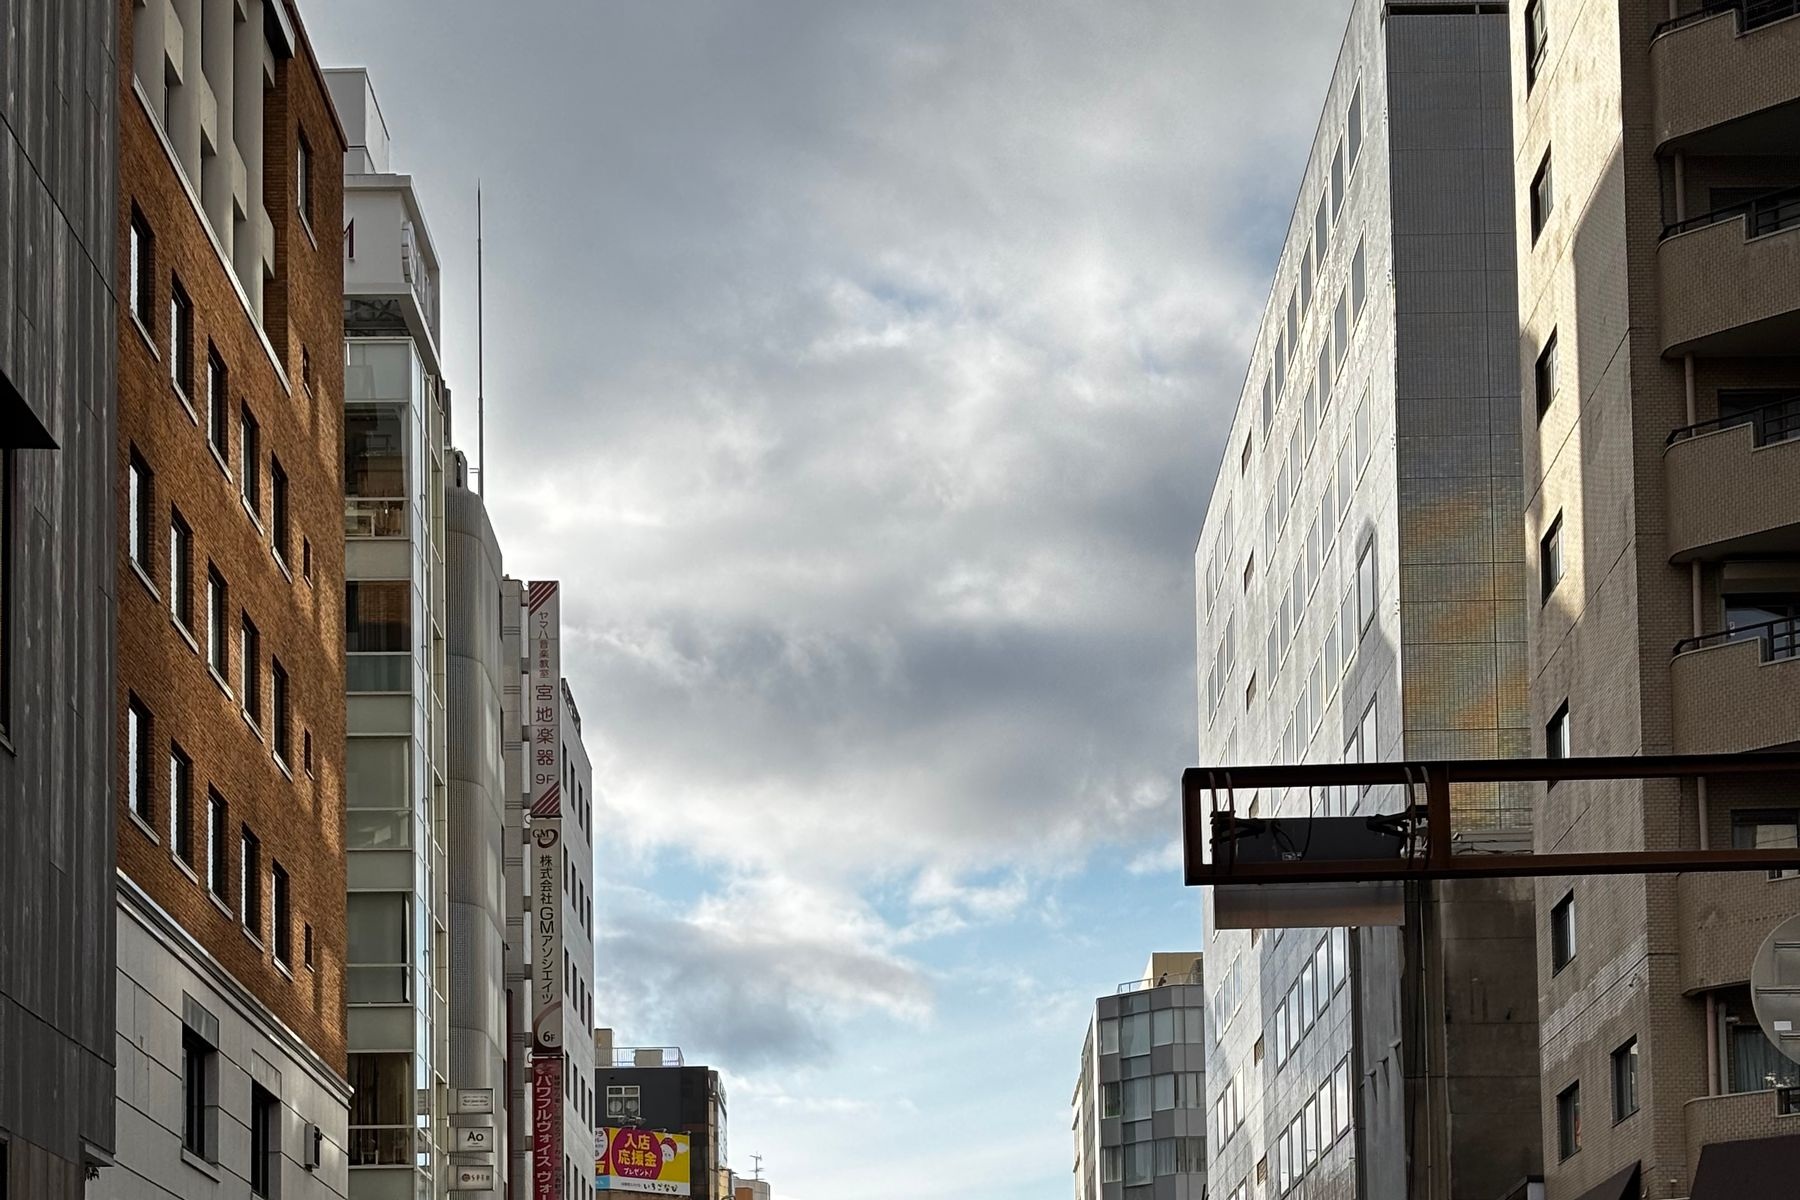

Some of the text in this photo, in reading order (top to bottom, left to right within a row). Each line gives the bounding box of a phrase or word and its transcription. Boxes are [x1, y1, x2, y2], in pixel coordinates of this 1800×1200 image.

[535, 684, 554, 767] 宮地楽器
[535, 773, 555, 785] 9F
[540, 854, 555, 1005] 株式会社GMアソシエイツ
[543, 1030, 556, 1042] 6F
[624, 1133, 651, 1151] 入店
[618, 1149, 657, 1168] 応援金
